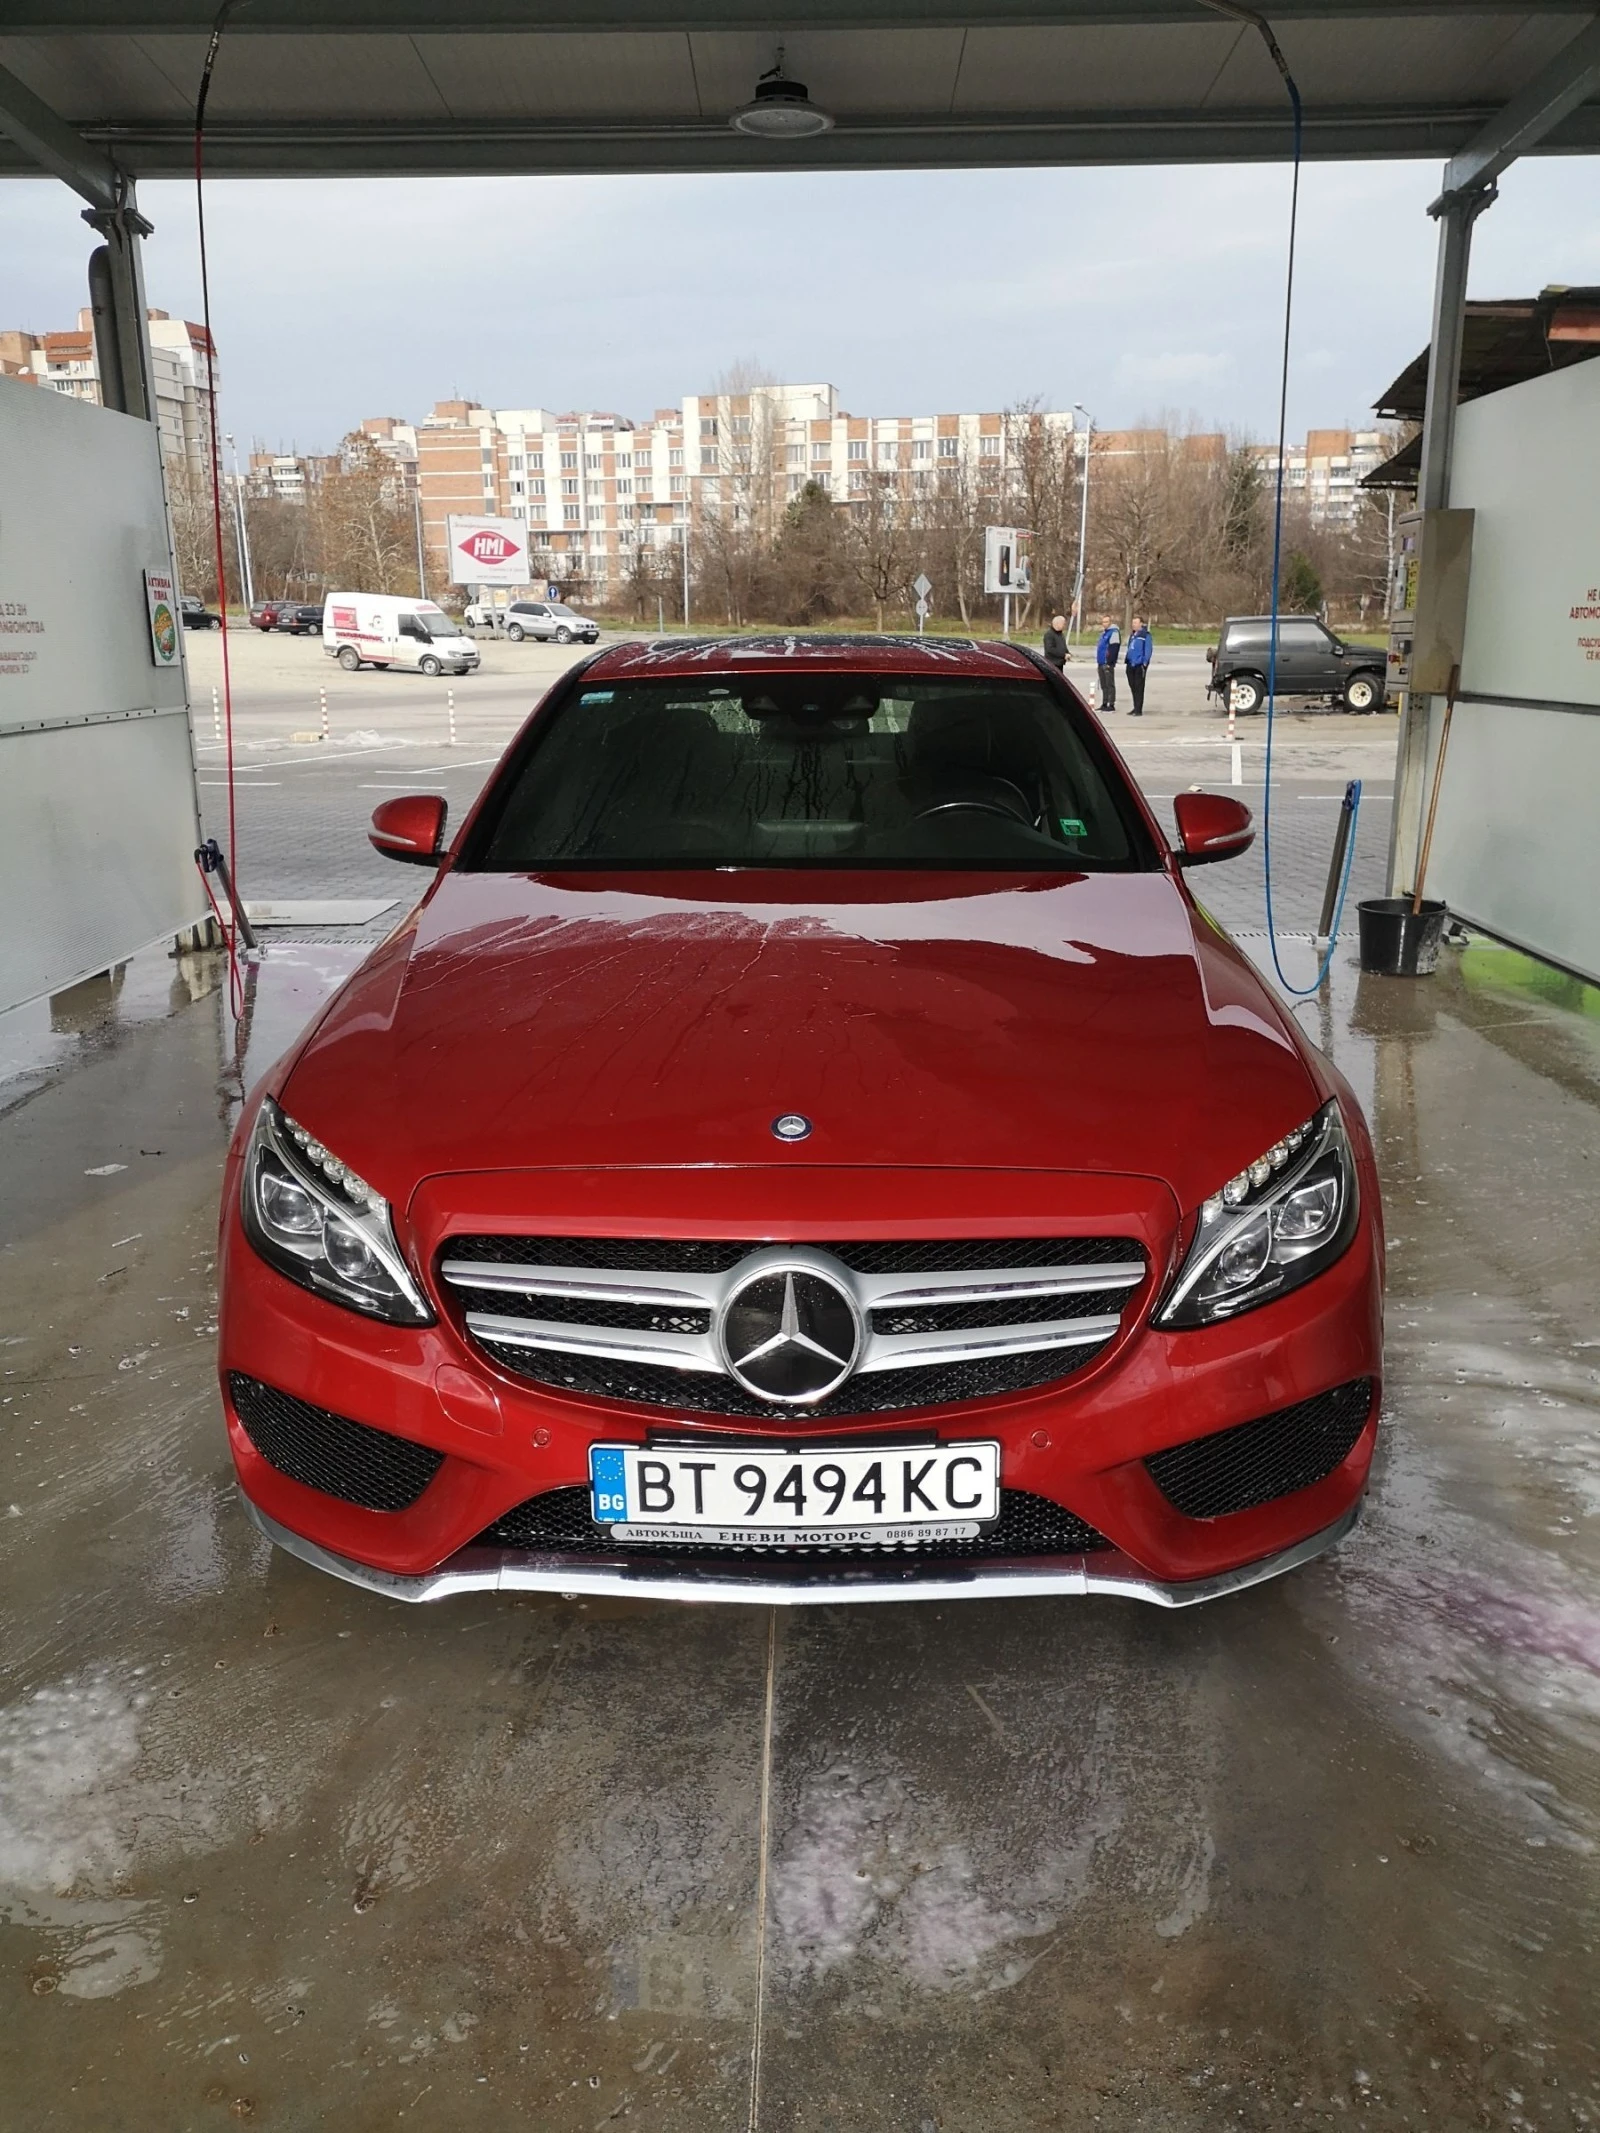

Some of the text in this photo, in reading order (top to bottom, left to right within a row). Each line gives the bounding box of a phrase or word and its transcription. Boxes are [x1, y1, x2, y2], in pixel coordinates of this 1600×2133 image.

[473, 537, 505, 556] HMI
[1587, 589, 1597, 601] НЕ
[637, 1456, 983, 1517] BT 9494 KC
[598, 1493, 625, 1511] BG
[625, 1527, 967, 1543] АВТОКЪЩА ЕНЕВИ МОТОРС 0886 89 87 17
